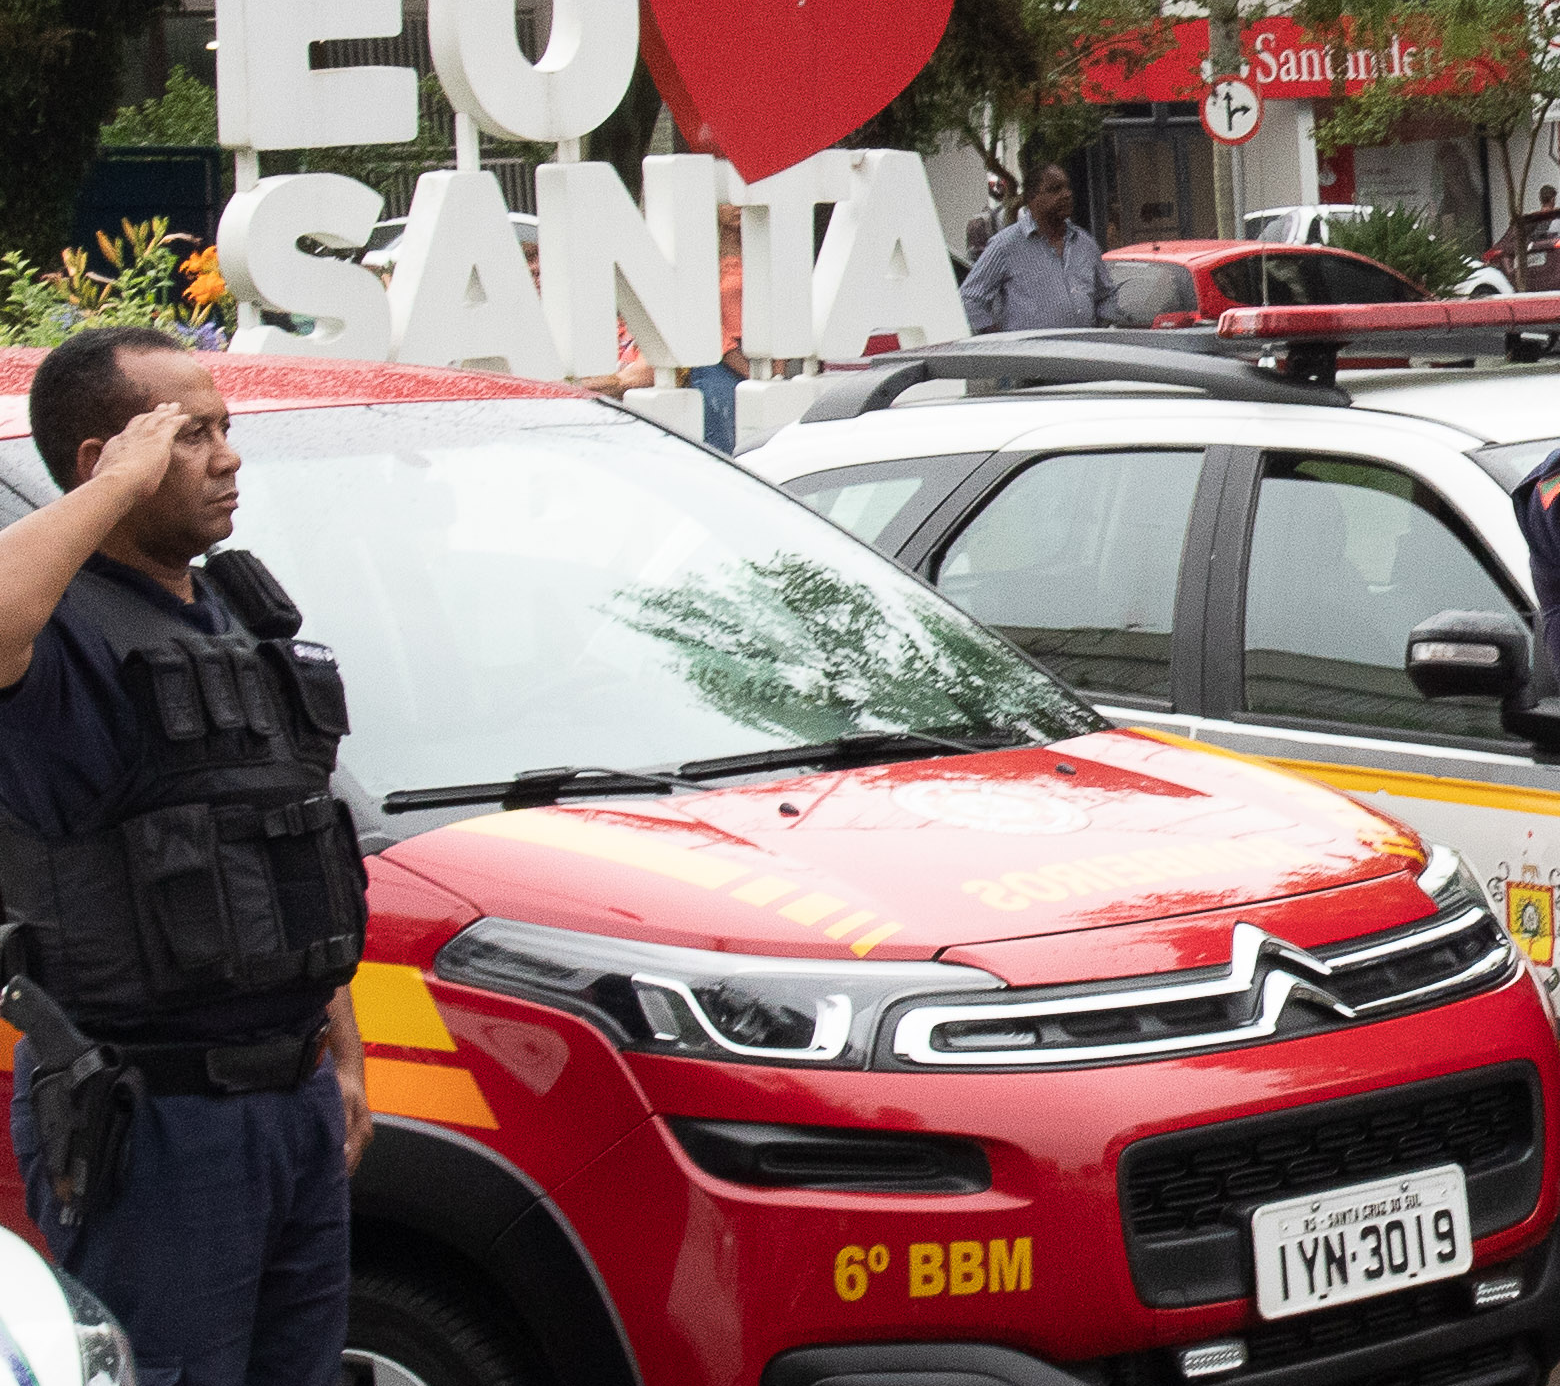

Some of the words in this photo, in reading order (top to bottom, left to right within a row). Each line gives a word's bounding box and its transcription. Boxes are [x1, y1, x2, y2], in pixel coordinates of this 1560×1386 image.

[217, 148, 973, 381] SANTA
[833, 1243, 890, 1302] 6º
[909, 1236, 1033, 1299] BBM
